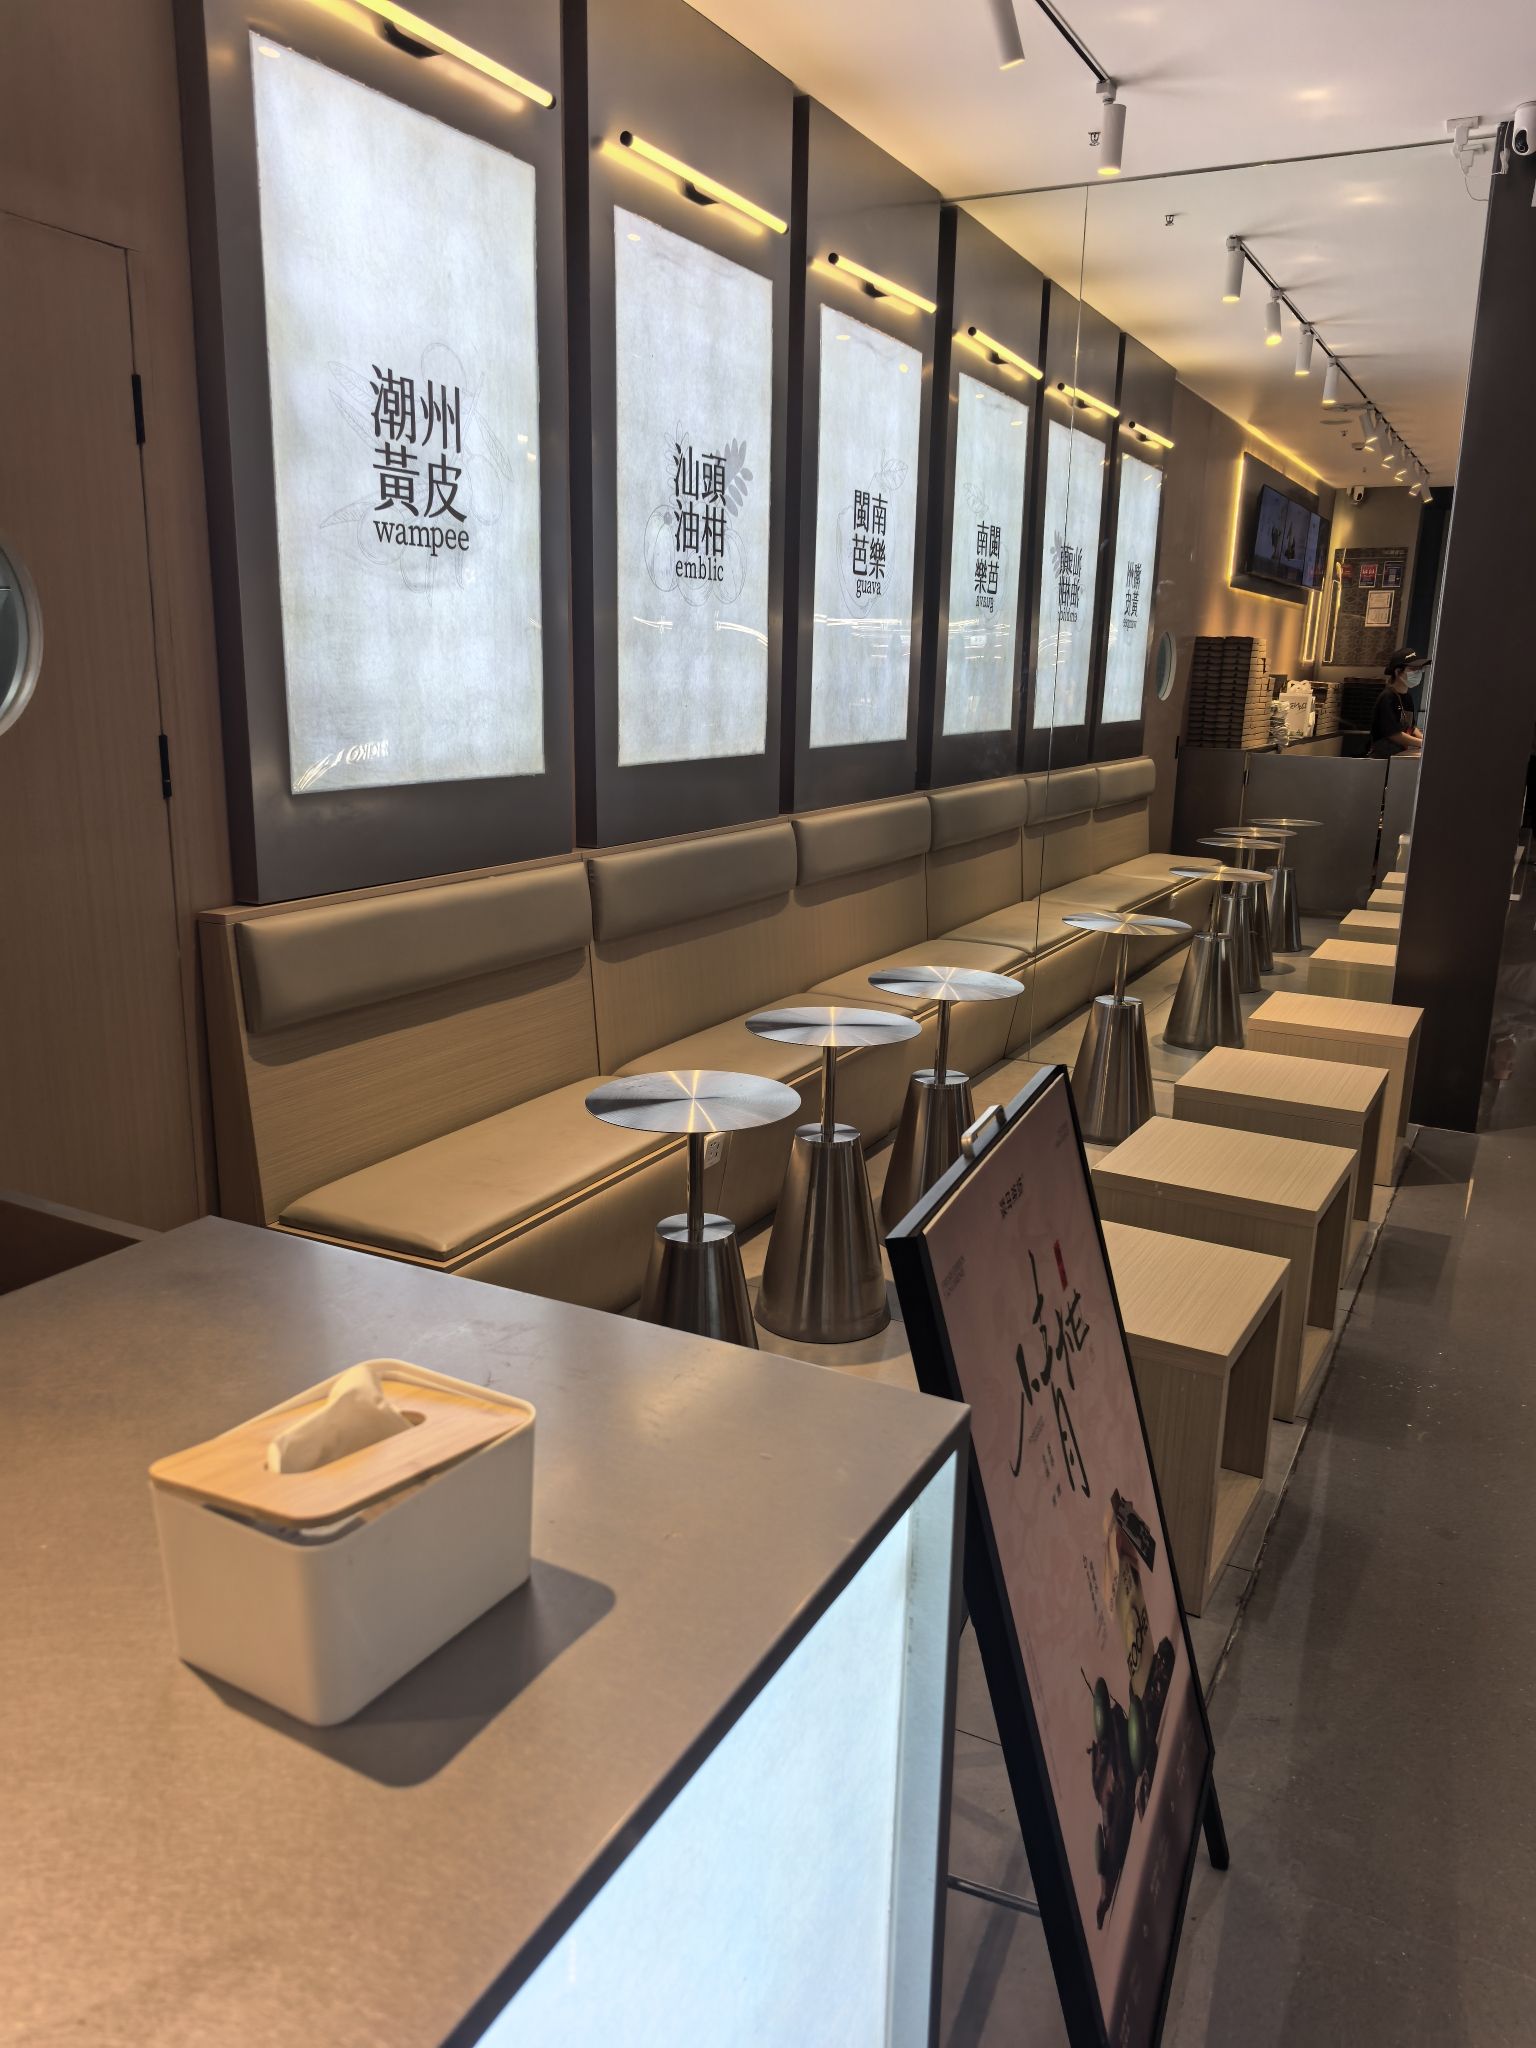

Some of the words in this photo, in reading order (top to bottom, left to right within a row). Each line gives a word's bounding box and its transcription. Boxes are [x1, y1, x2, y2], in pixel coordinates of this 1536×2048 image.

[369, 363, 462, 454] 潮州
[372, 441, 468, 523] 黃皮
[673, 442, 727, 507] 汕頭
[674, 499, 727, 558] 油柑
[853, 489, 888, 537] 閩南
[373, 520, 470, 557] wampee
[852, 533, 886, 580] 芭樂
[675, 555, 724, 581] emblic
[856, 578, 882, 598] guava
